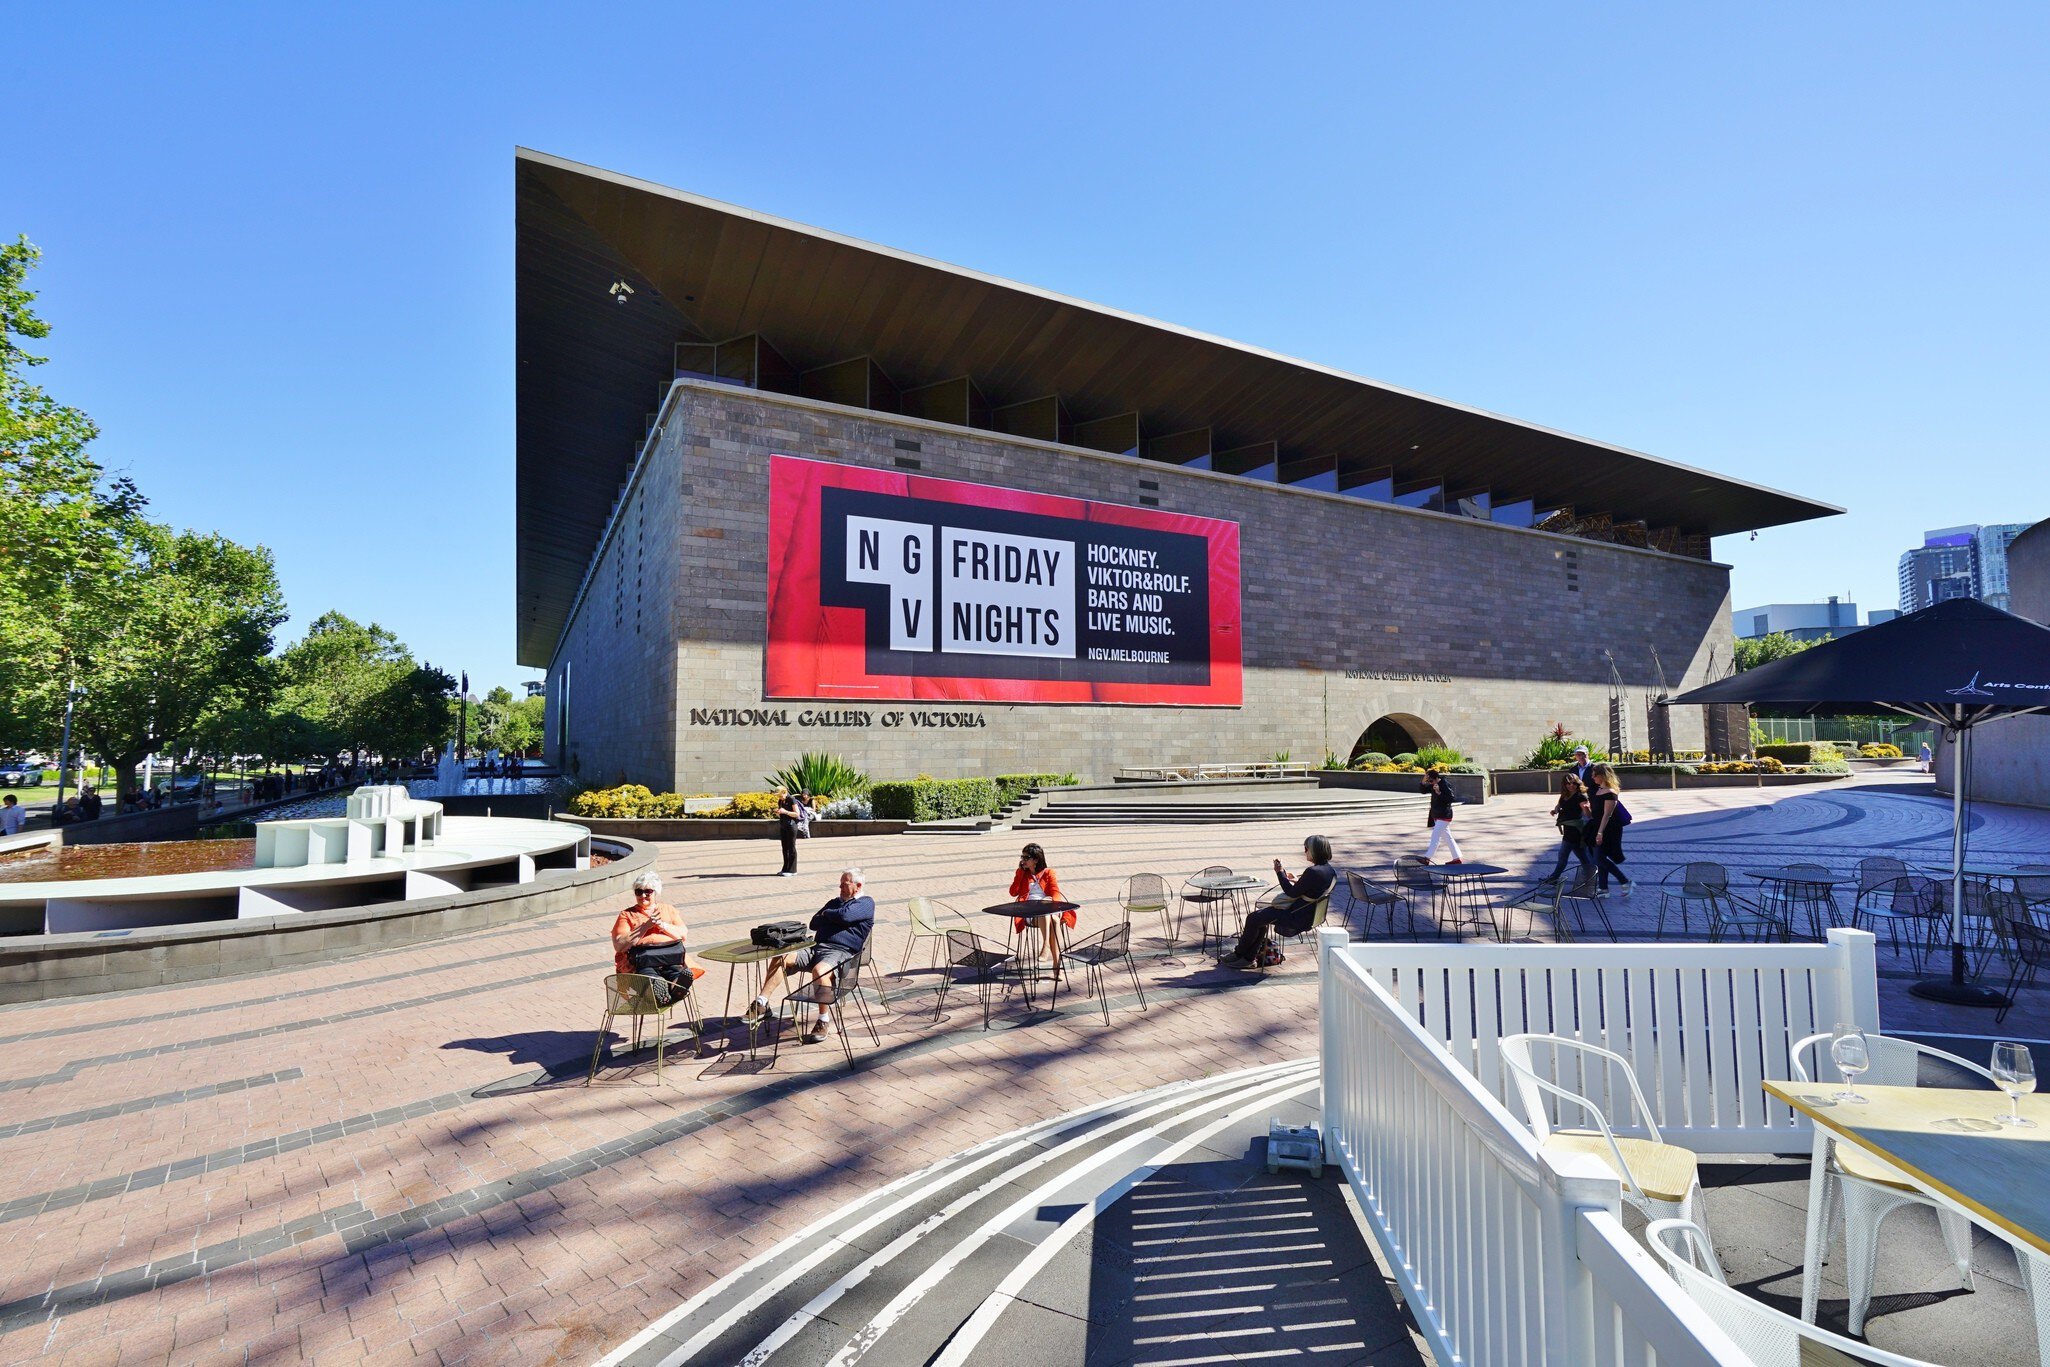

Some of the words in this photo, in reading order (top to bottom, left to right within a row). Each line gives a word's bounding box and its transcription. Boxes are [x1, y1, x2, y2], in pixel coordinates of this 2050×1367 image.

[953, 539, 1060, 587] FRIDAY
[1087, 543, 1160, 569] HOCKNEY.
[1087, 566, 1192, 594] VIKTOR&ROLF.
[1088, 588, 1128, 610] BARS
[1132, 593, 1163, 613] AND
[902, 598, 922, 639] V
[953, 602, 1060, 646] NIGHTS
[1088, 611, 1121, 632] LIVE
[1125, 614, 1176, 636] MUSIC.
[1088, 647, 1170, 664] NGV.MELBOURNE
[1345, 669, 1380, 680] NATIONAL
[1382, 671, 1411, 682] GALLERY
[1411, 673, 1421, 682] OF
[1422, 673, 1452, 683] VICTORIA
[689, 708, 791, 727] NATIONAL
[797, 710, 875, 728] GALLERY
[881, 711, 904, 728] OF
[909, 711, 987, 728] VICTORIA
